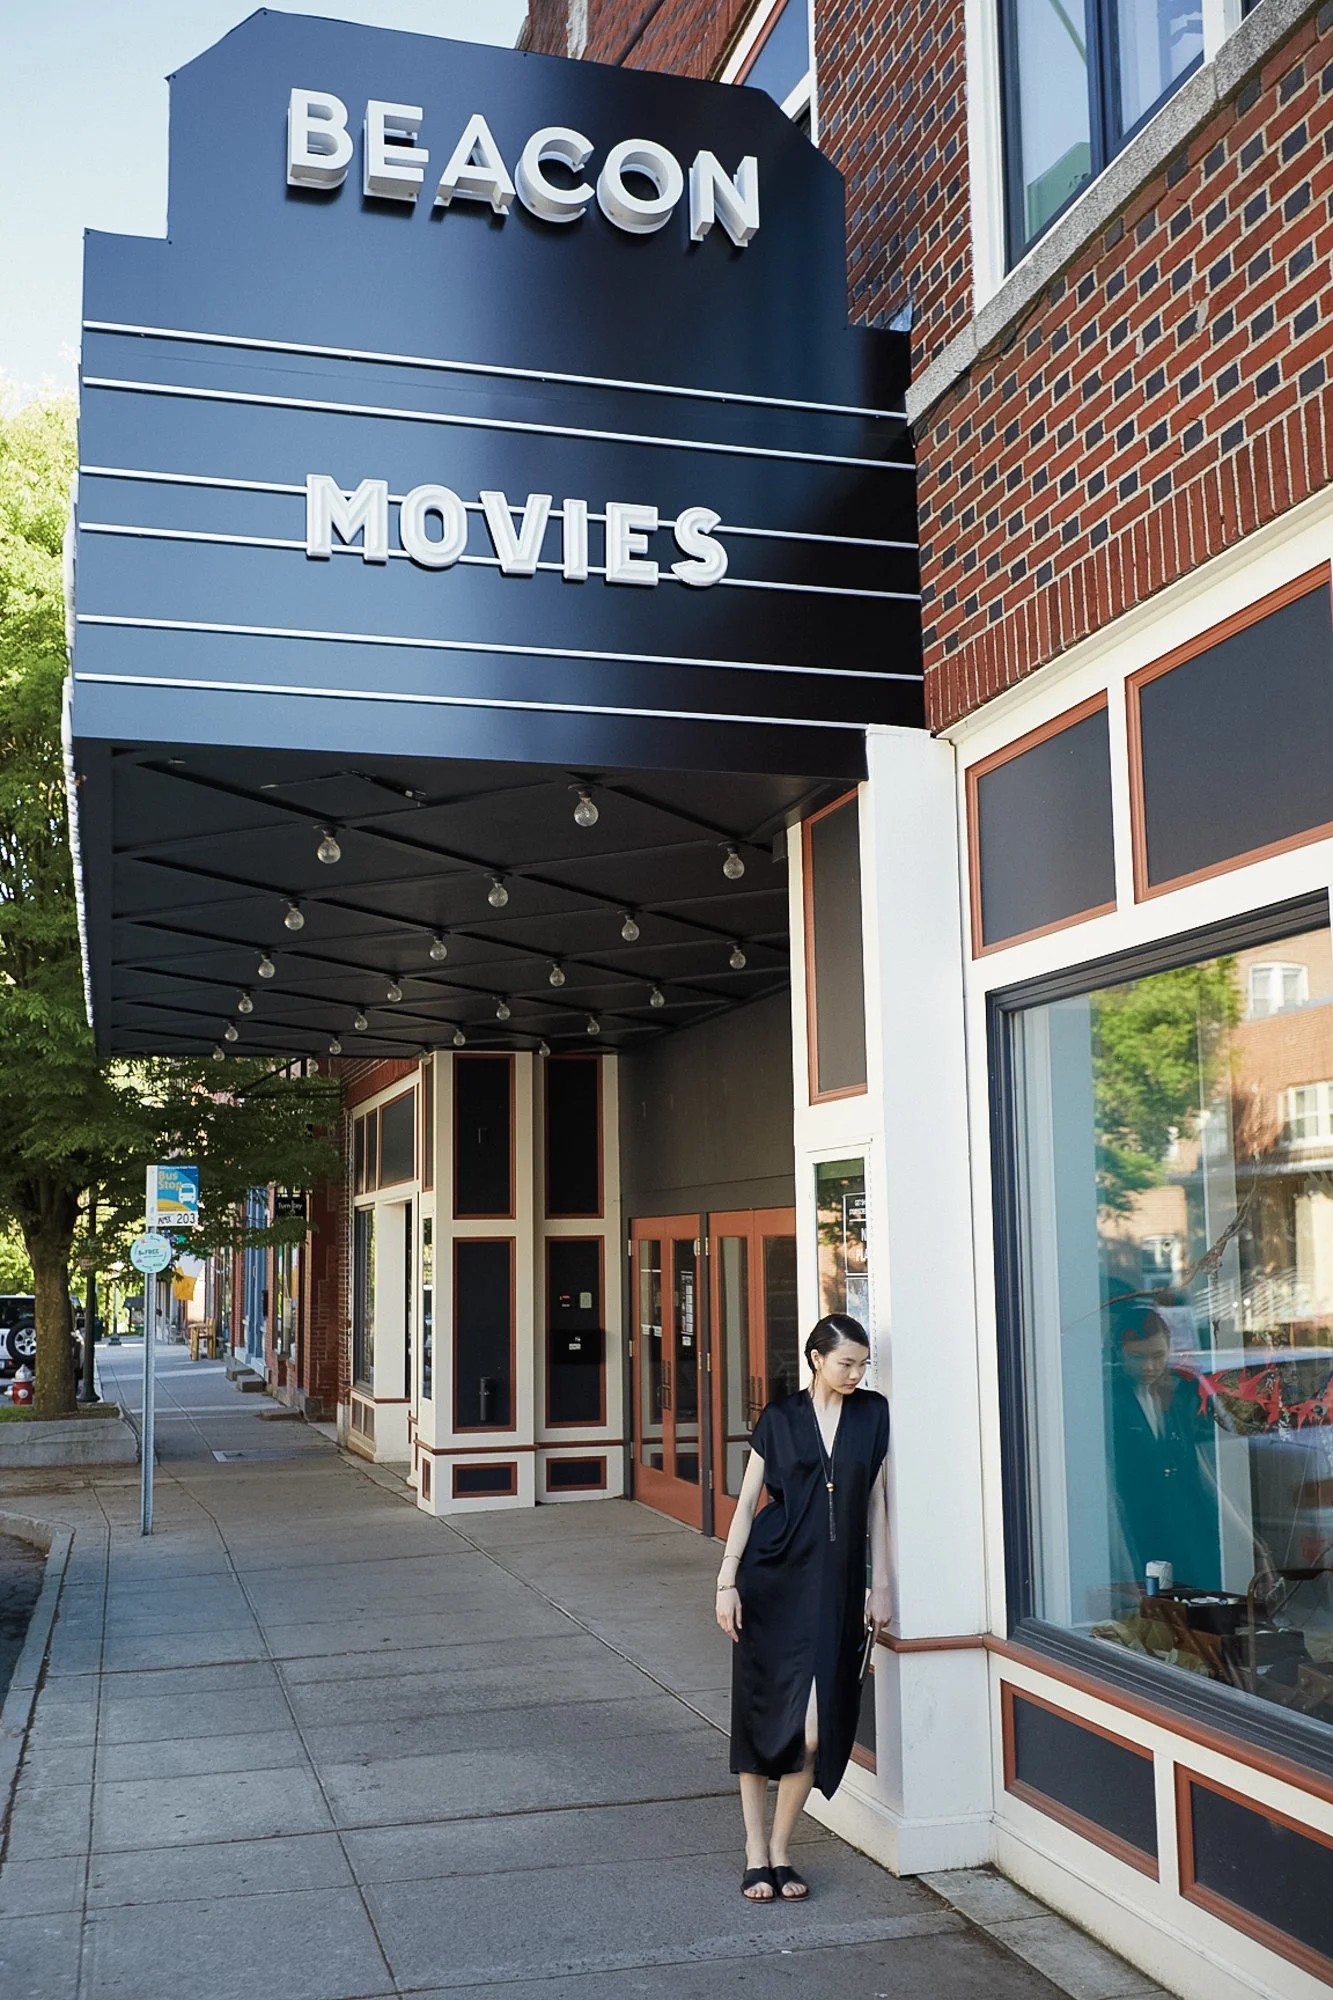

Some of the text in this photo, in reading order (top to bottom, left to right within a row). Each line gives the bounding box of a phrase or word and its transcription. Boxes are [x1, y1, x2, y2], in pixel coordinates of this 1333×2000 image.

[286, 88, 760, 247] BEACON
[306, 473, 728, 587] MOVIES
[158, 1170, 178, 1181] Bus
[158, 1181, 183, 1191] Stop
[176, 1213, 196, 1224] 203
